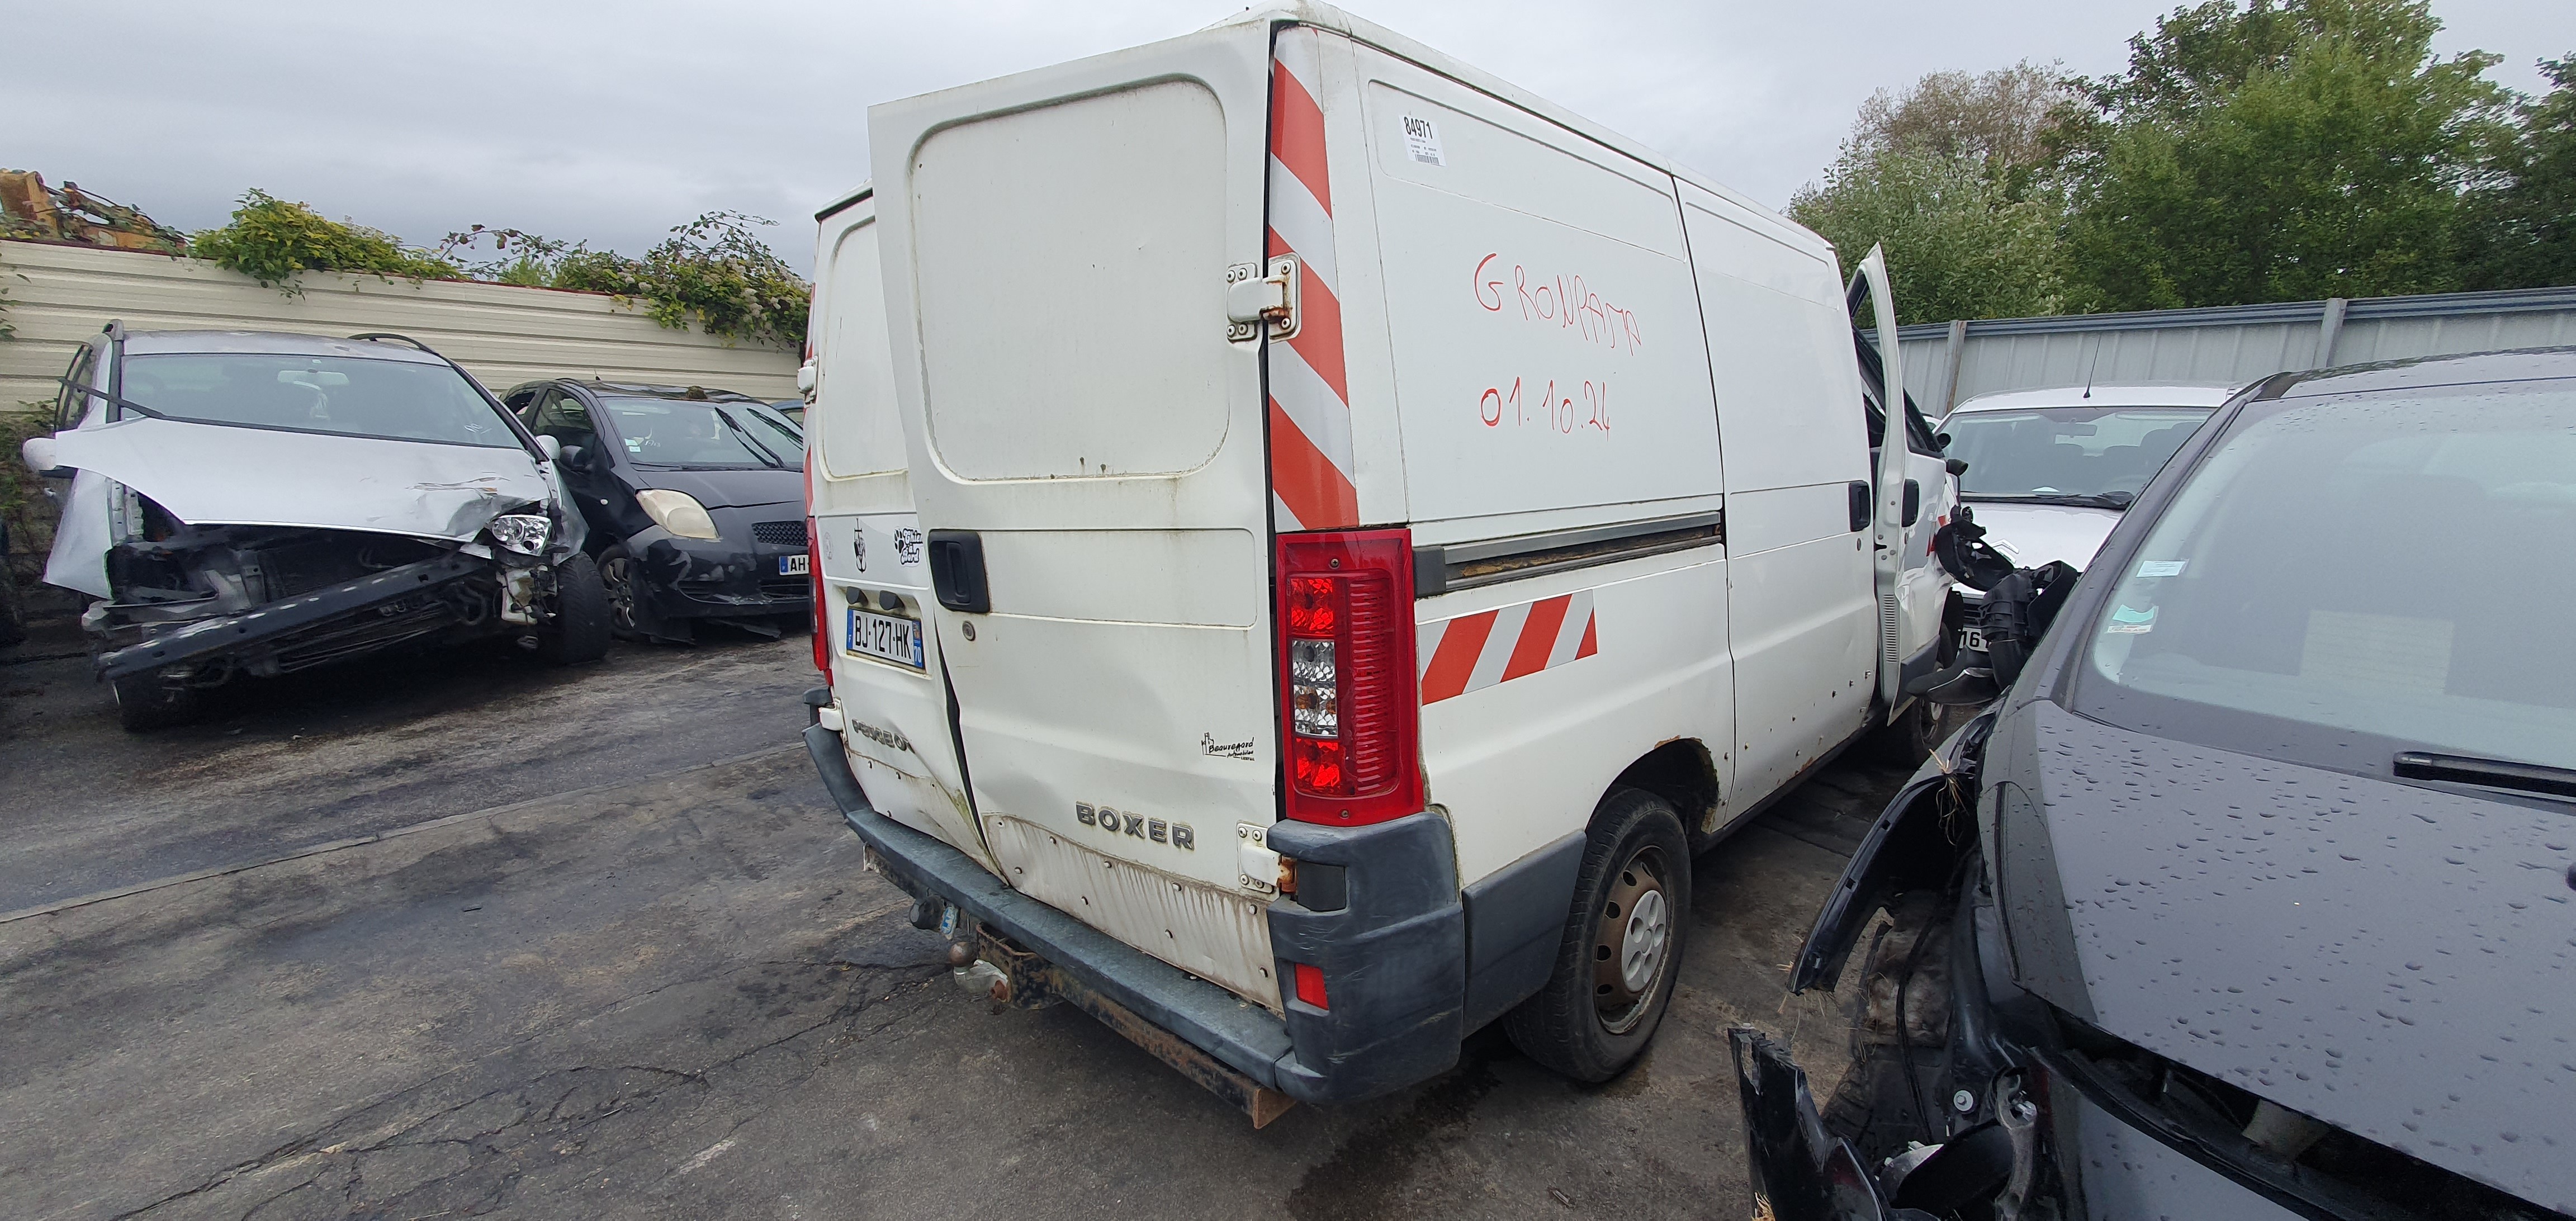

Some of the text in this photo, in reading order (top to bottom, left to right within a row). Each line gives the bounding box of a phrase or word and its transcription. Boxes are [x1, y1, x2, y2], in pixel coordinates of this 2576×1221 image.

[1404, 116, 1433, 139] 84971
[1481, 376, 1610, 442] 01.10.24
[855, 616, 911, 659] BJ-127-HK
[914, 646, 922, 663] 70
[1076, 802, 1195, 851] BOXER
